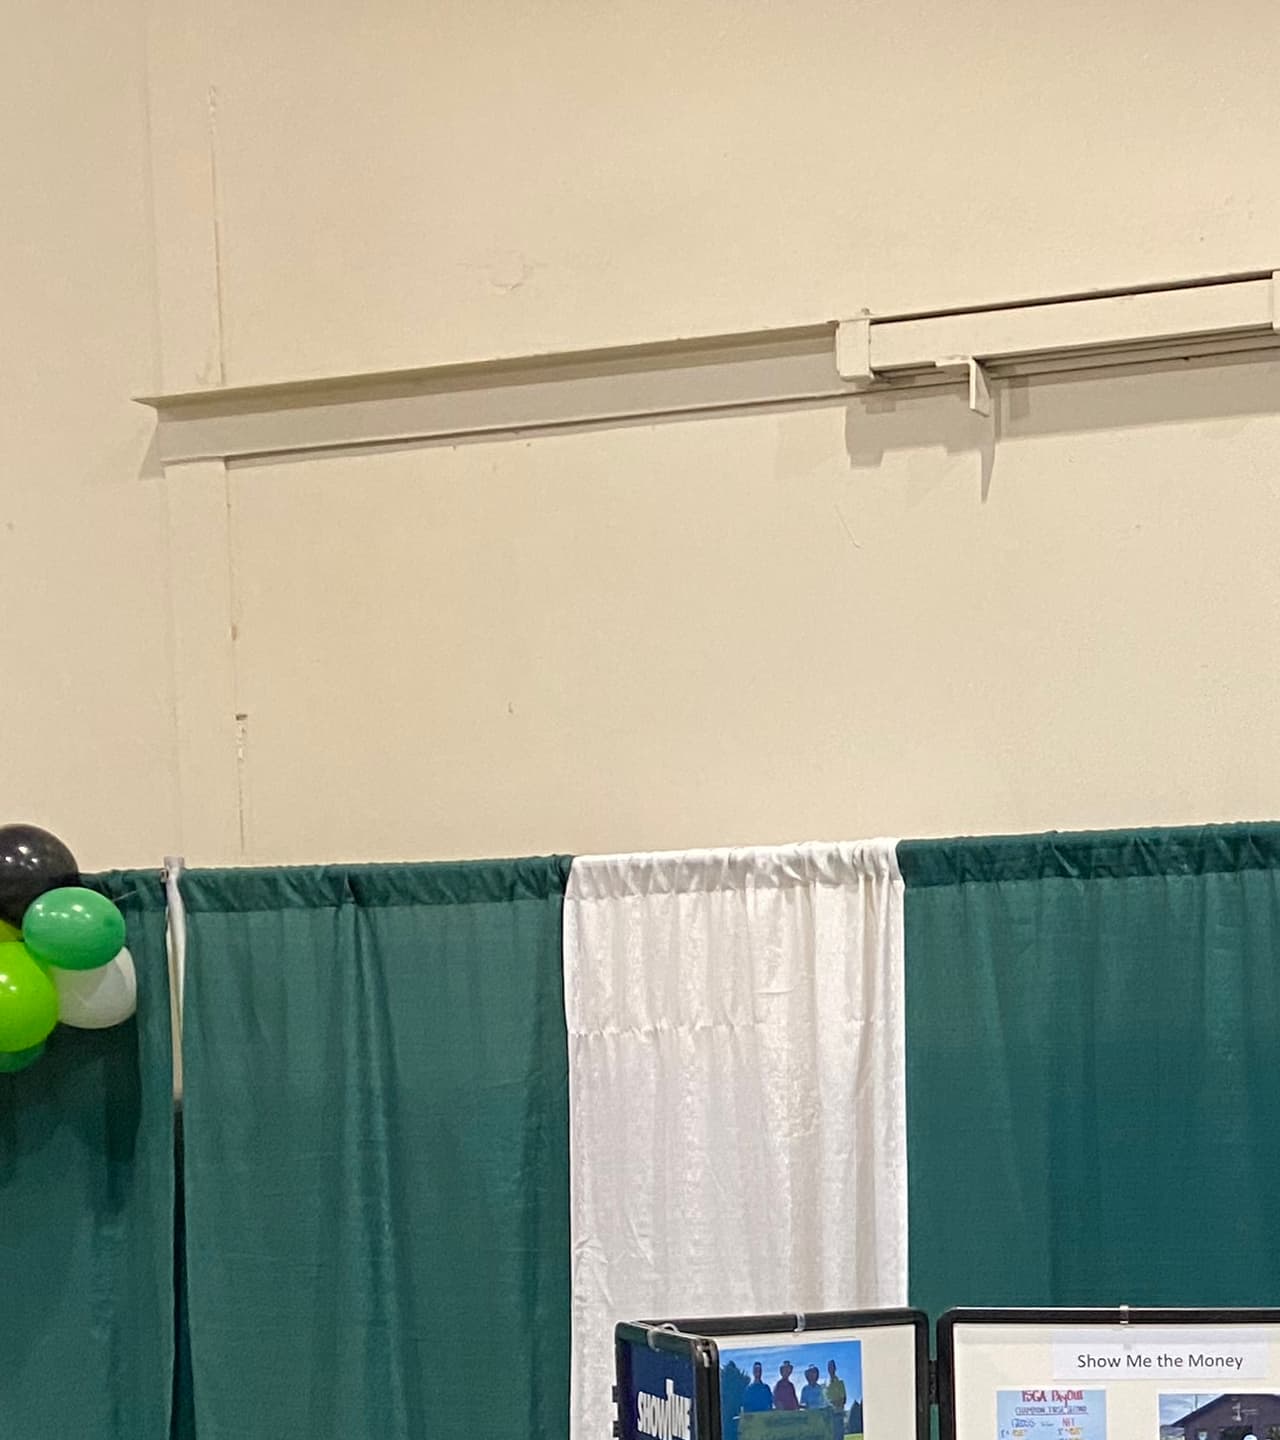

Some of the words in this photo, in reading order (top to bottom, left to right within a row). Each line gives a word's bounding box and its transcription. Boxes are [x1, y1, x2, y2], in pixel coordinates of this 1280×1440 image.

[1077, 1354, 1121, 1368] Show
[1126, 1354, 1151, 1368] Me
[1157, 1353, 1183, 1367] the
[1188, 1354, 1243, 1370] Money
